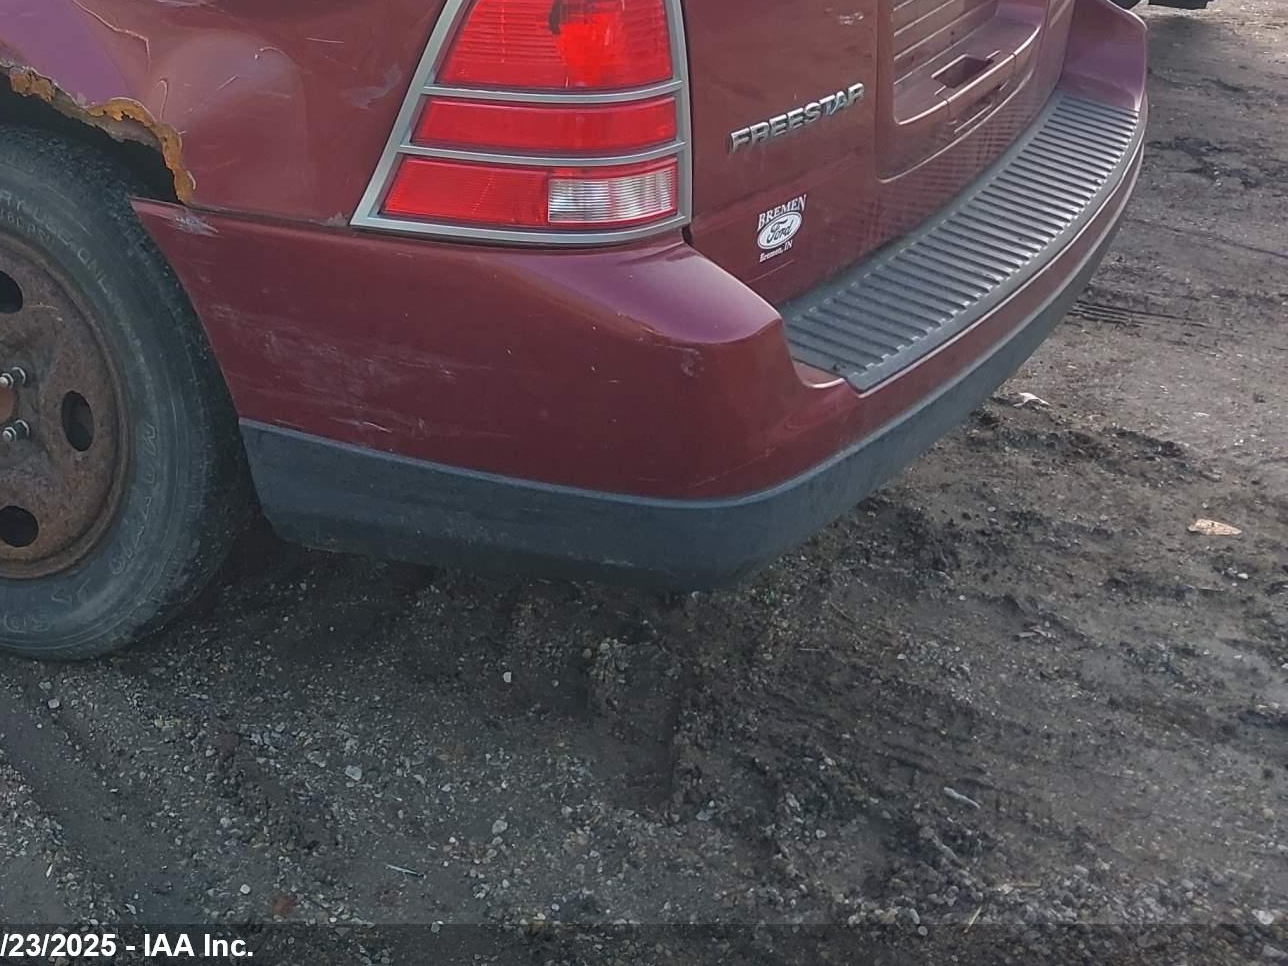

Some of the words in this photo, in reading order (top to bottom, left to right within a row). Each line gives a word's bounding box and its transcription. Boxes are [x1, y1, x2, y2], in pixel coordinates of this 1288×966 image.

[728, 82, 865, 154] FREESTAR
[757, 194, 807, 232] BREMEN
[766, 218, 795, 244] Ford
